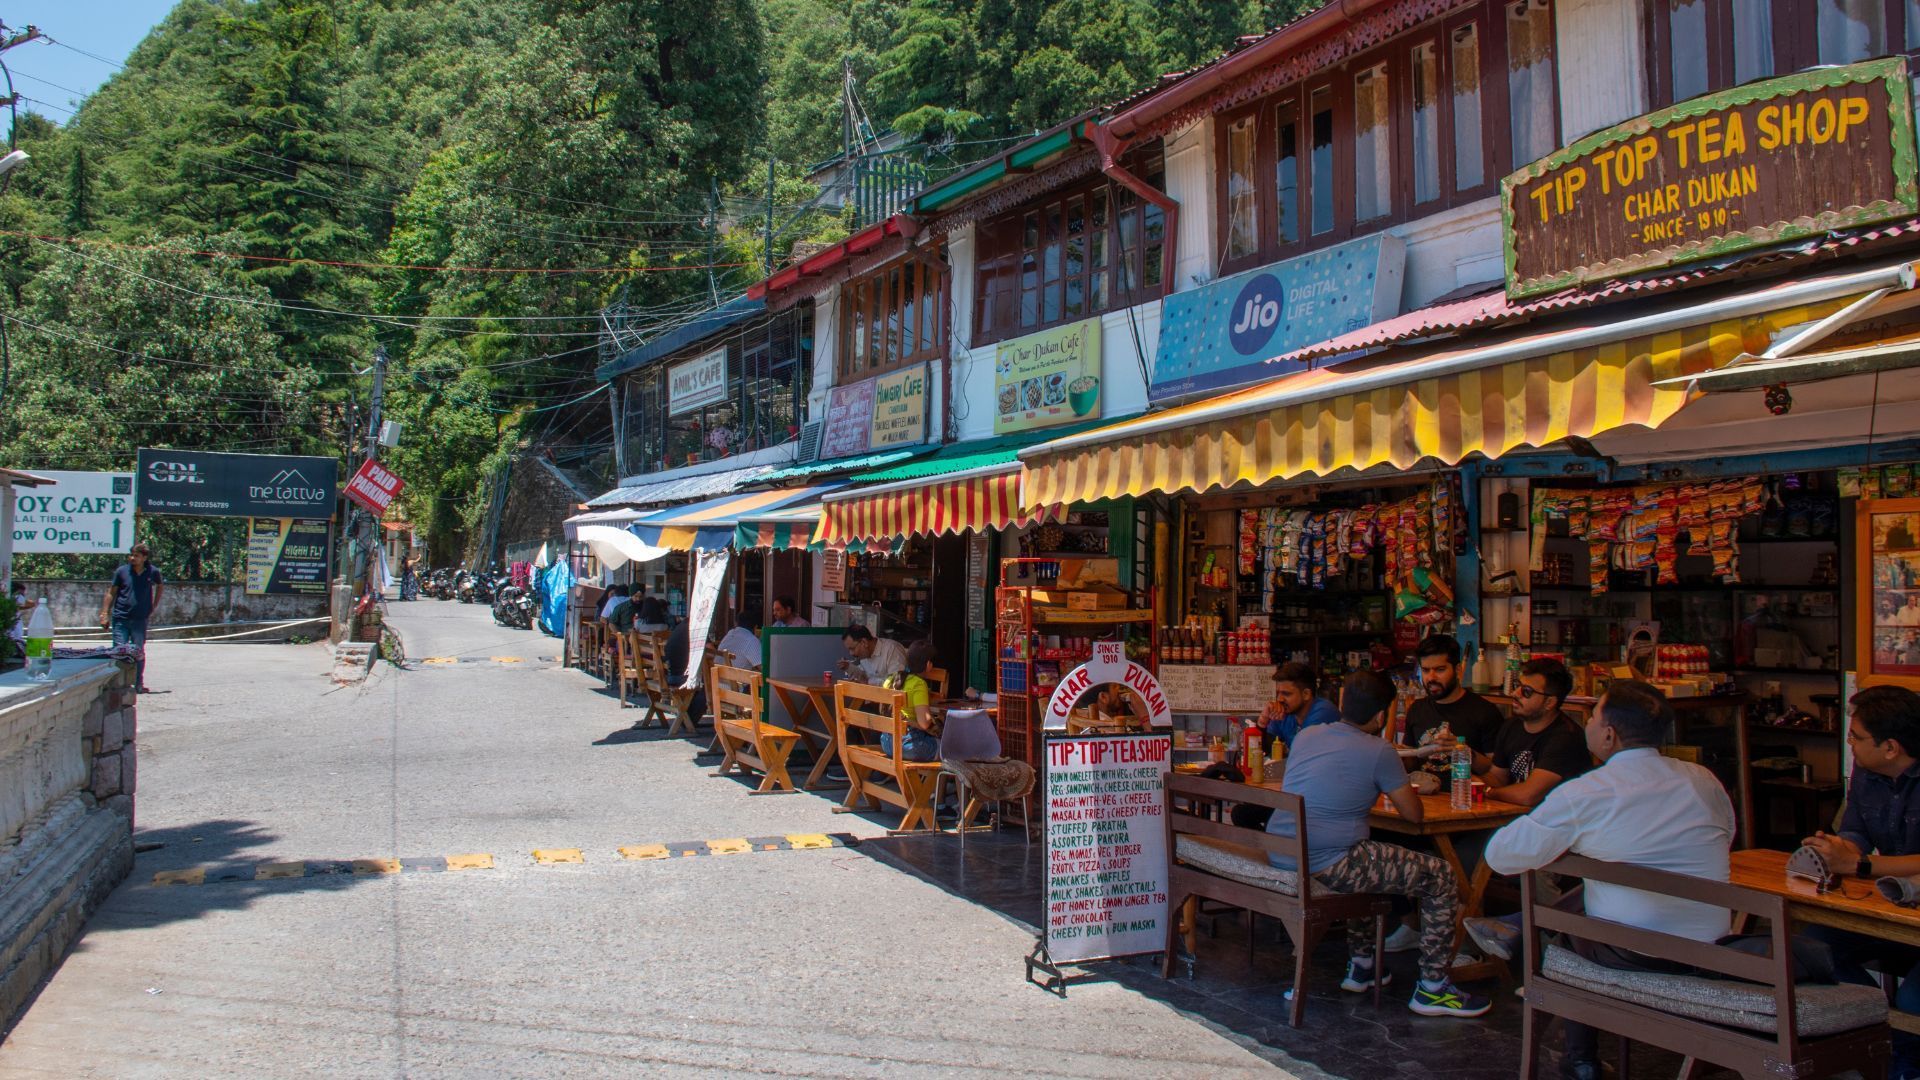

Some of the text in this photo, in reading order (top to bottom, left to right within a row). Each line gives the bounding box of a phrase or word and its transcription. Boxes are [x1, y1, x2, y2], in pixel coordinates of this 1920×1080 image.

[1530, 97, 1870, 224] TIP TOP TEA SHOP
[1623, 164, 1758, 223] CHAR DUKAN
[1289, 278, 1339, 304] DIGITAL
[1234, 293, 1279, 334] Jio
[1287, 300, 1315, 320] LIFE
[1013, 347, 1031, 365] Char
[1033, 341, 1059, 361] Dukan
[673, 362, 721, 397] ANIL'S CAFE
[876, 375, 922, 404] HIMGIRI CAFE
[148, 461, 205, 484] CDL
[367, 464, 397, 491] PAID
[352, 474, 393, 508] PARKING
[16, 496, 126, 514] OY CAFE
[15, 515, 73, 523] LAL TIBBA
[12, 527, 91, 545] ow Open
[285, 545, 325, 557] HIGHH FLY
[1097, 643, 1120, 654] SINCE
[1102, 654, 1119, 664] 1910
[1052, 667, 1093, 718] CHAR
[1123, 663, 1167, 718] DUKAN
[1048, 738, 1171, 767] TIP TOP TEA SHOP
[1069, 770, 1100, 782] OMELETTE
[1101, 769, 1116, 780] WITH
[1116, 767, 1128, 779] VEG
[1133, 767, 1158, 778] CHEESE
[1066, 782, 1100, 794] SANDWICH
[1104, 780, 1130, 792] CHEESE
[1124, 792, 1152, 805] CHEESE
[1051, 809, 1082, 822] MASALA
[1084, 807, 1105, 820] FRIES
[1111, 806, 1138, 818] CHEESY
[1141, 805, 1162, 816] FRIES
[1051, 819, 1128, 835] STUFFED PARATHA
[1051, 832, 1130, 849] ASSORTED PAKORA
[1051, 849, 1066, 861] VEG
[1069, 848, 1092, 860] MOMOS
[1097, 847, 1111, 858] VEG
[1114, 844, 1142, 856] BURGER
[1051, 862, 1075, 875] EXOTIC
[1078, 860, 1100, 872] PIZZA
[1108, 857, 1131, 869] SOUPS
[1051, 874, 1089, 887] PANCAKES
[1097, 870, 1131, 883] WAFFLES
[1051, 887, 1072, 900] MILK
[1074, 885, 1104, 899] SHAKES
[1111, 880, 1156, 895] MOCKTAILS
[1051, 893, 1166, 913] HOT HONEY LEMON GINGER TEA
[1051, 911, 1113, 926] HOT CHOCOLATE
[1051, 926, 1084, 939] CHEESY
[1086, 924, 1103, 937] BUN
[1112, 921, 1128, 933] BUN
[1130, 919, 1156, 931] MASKA
